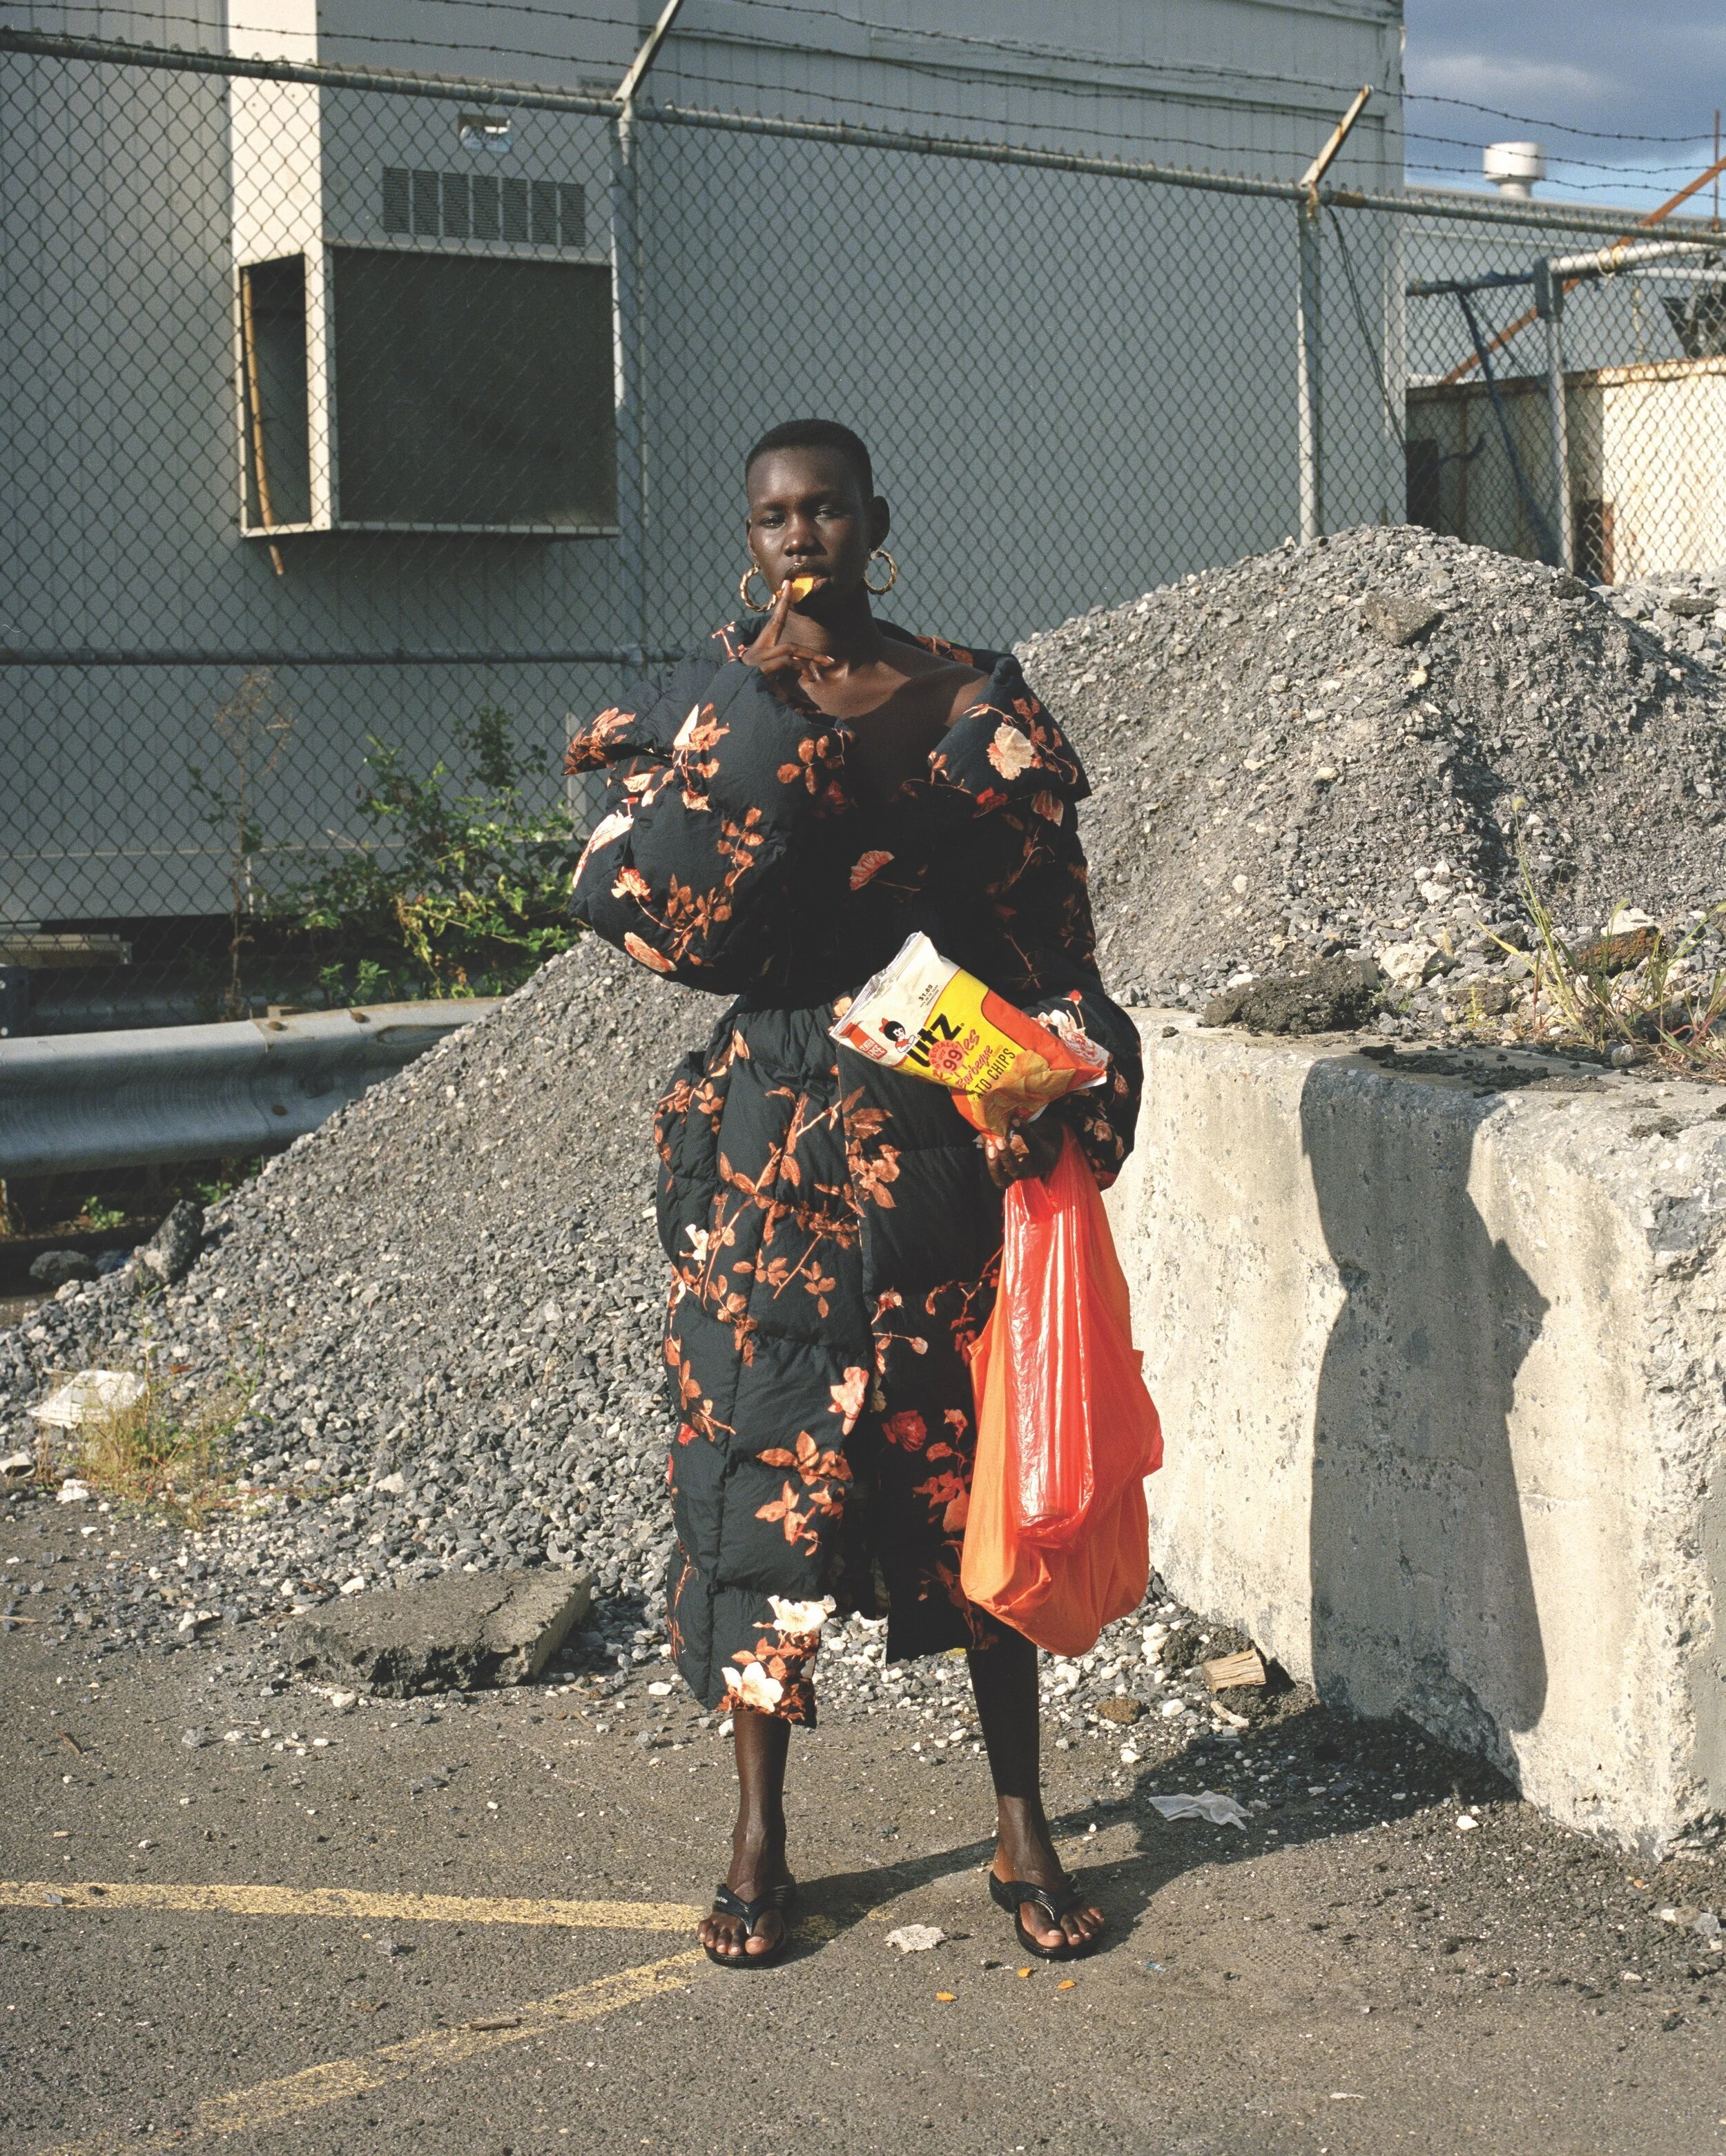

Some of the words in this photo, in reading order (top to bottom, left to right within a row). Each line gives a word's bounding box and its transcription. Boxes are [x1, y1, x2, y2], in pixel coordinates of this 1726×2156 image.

[918, 984, 933, 1000] $1.89
[930, 1042, 958, 1069] SPECIALS
[943, 1049, 962, 1071] 99
[956, 1045, 993, 1089] Barbeque
[987, 1048, 1016, 1080] CHIPS
